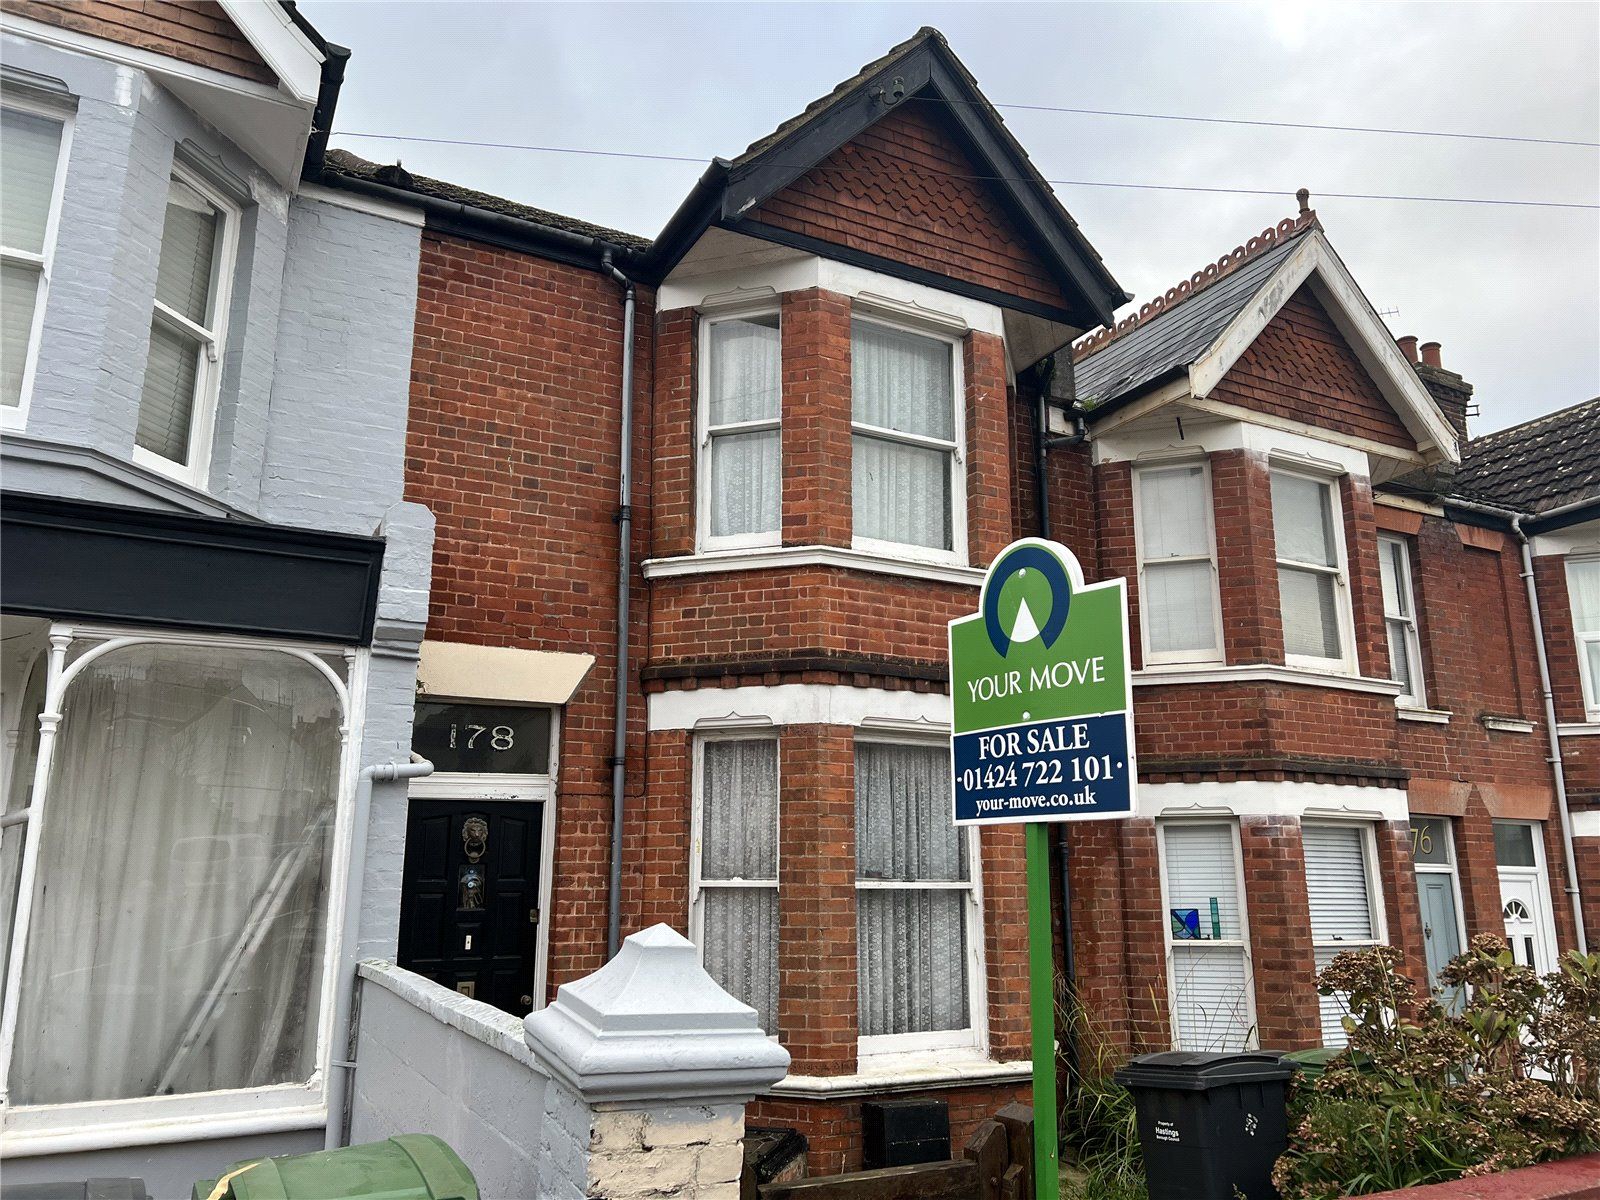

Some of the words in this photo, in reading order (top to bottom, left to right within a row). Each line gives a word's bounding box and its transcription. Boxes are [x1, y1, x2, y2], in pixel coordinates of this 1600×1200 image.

[968, 670, 1022, 703] YOUR
[1029, 656, 1105, 692] MOVE
[449, 723, 514, 750] 178
[978, 731, 1022, 760] FOR
[1027, 723, 1090, 754] SALE
[1022, 759, 1063, 787] 722
[976, 785, 1097, 816] your-move.co.uk
[1156, 1126, 1179, 1137] Hastings
